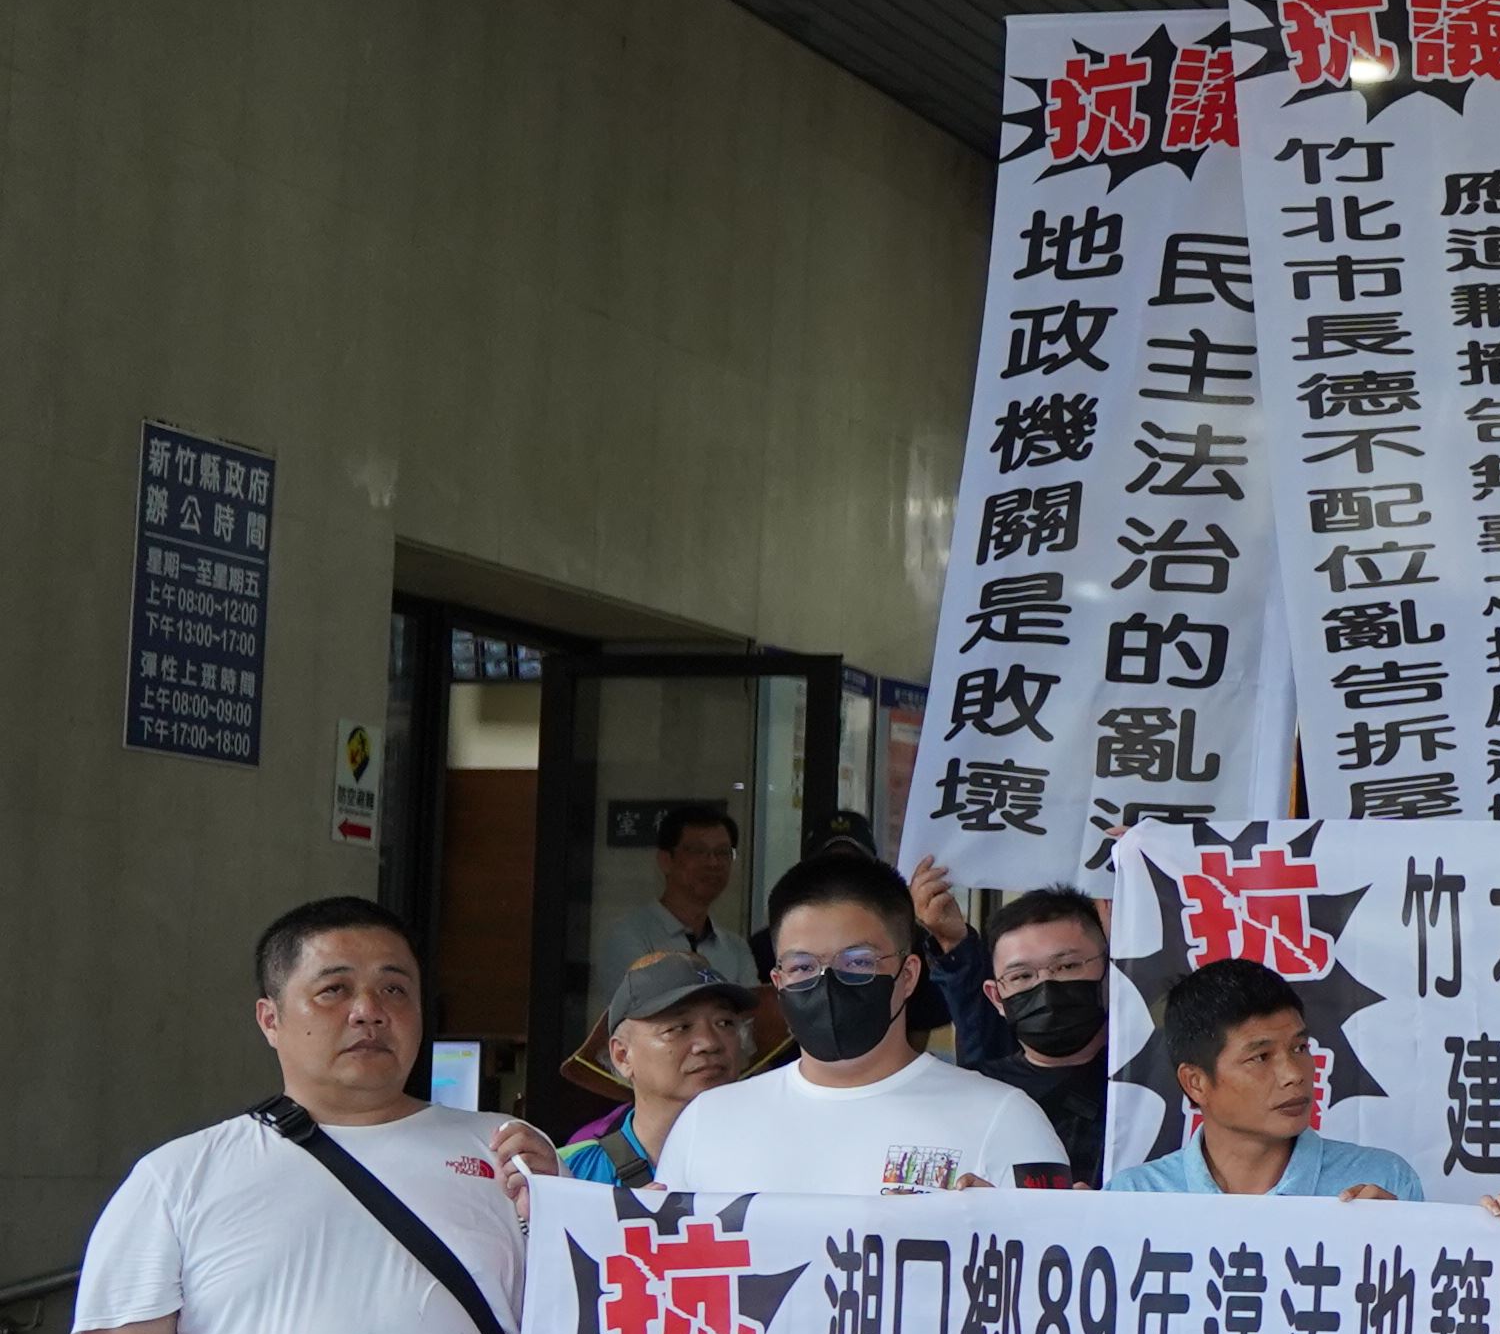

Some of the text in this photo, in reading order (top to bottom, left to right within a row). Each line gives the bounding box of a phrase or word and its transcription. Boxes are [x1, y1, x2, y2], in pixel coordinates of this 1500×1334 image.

[1045, 46, 1241, 161] 抗議
[149, 438, 270, 507] 新竹縣政府
[1274, 137, 1463, 819] 竹北市長德不配位亂告拆屋
[146, 483, 266, 552] 辦公時間
[931, 207, 1123, 835] 地政機關是敗壞
[147, 547, 260, 599] 星期一至星期五
[140, 650, 256, 698] 彈性上班時間
